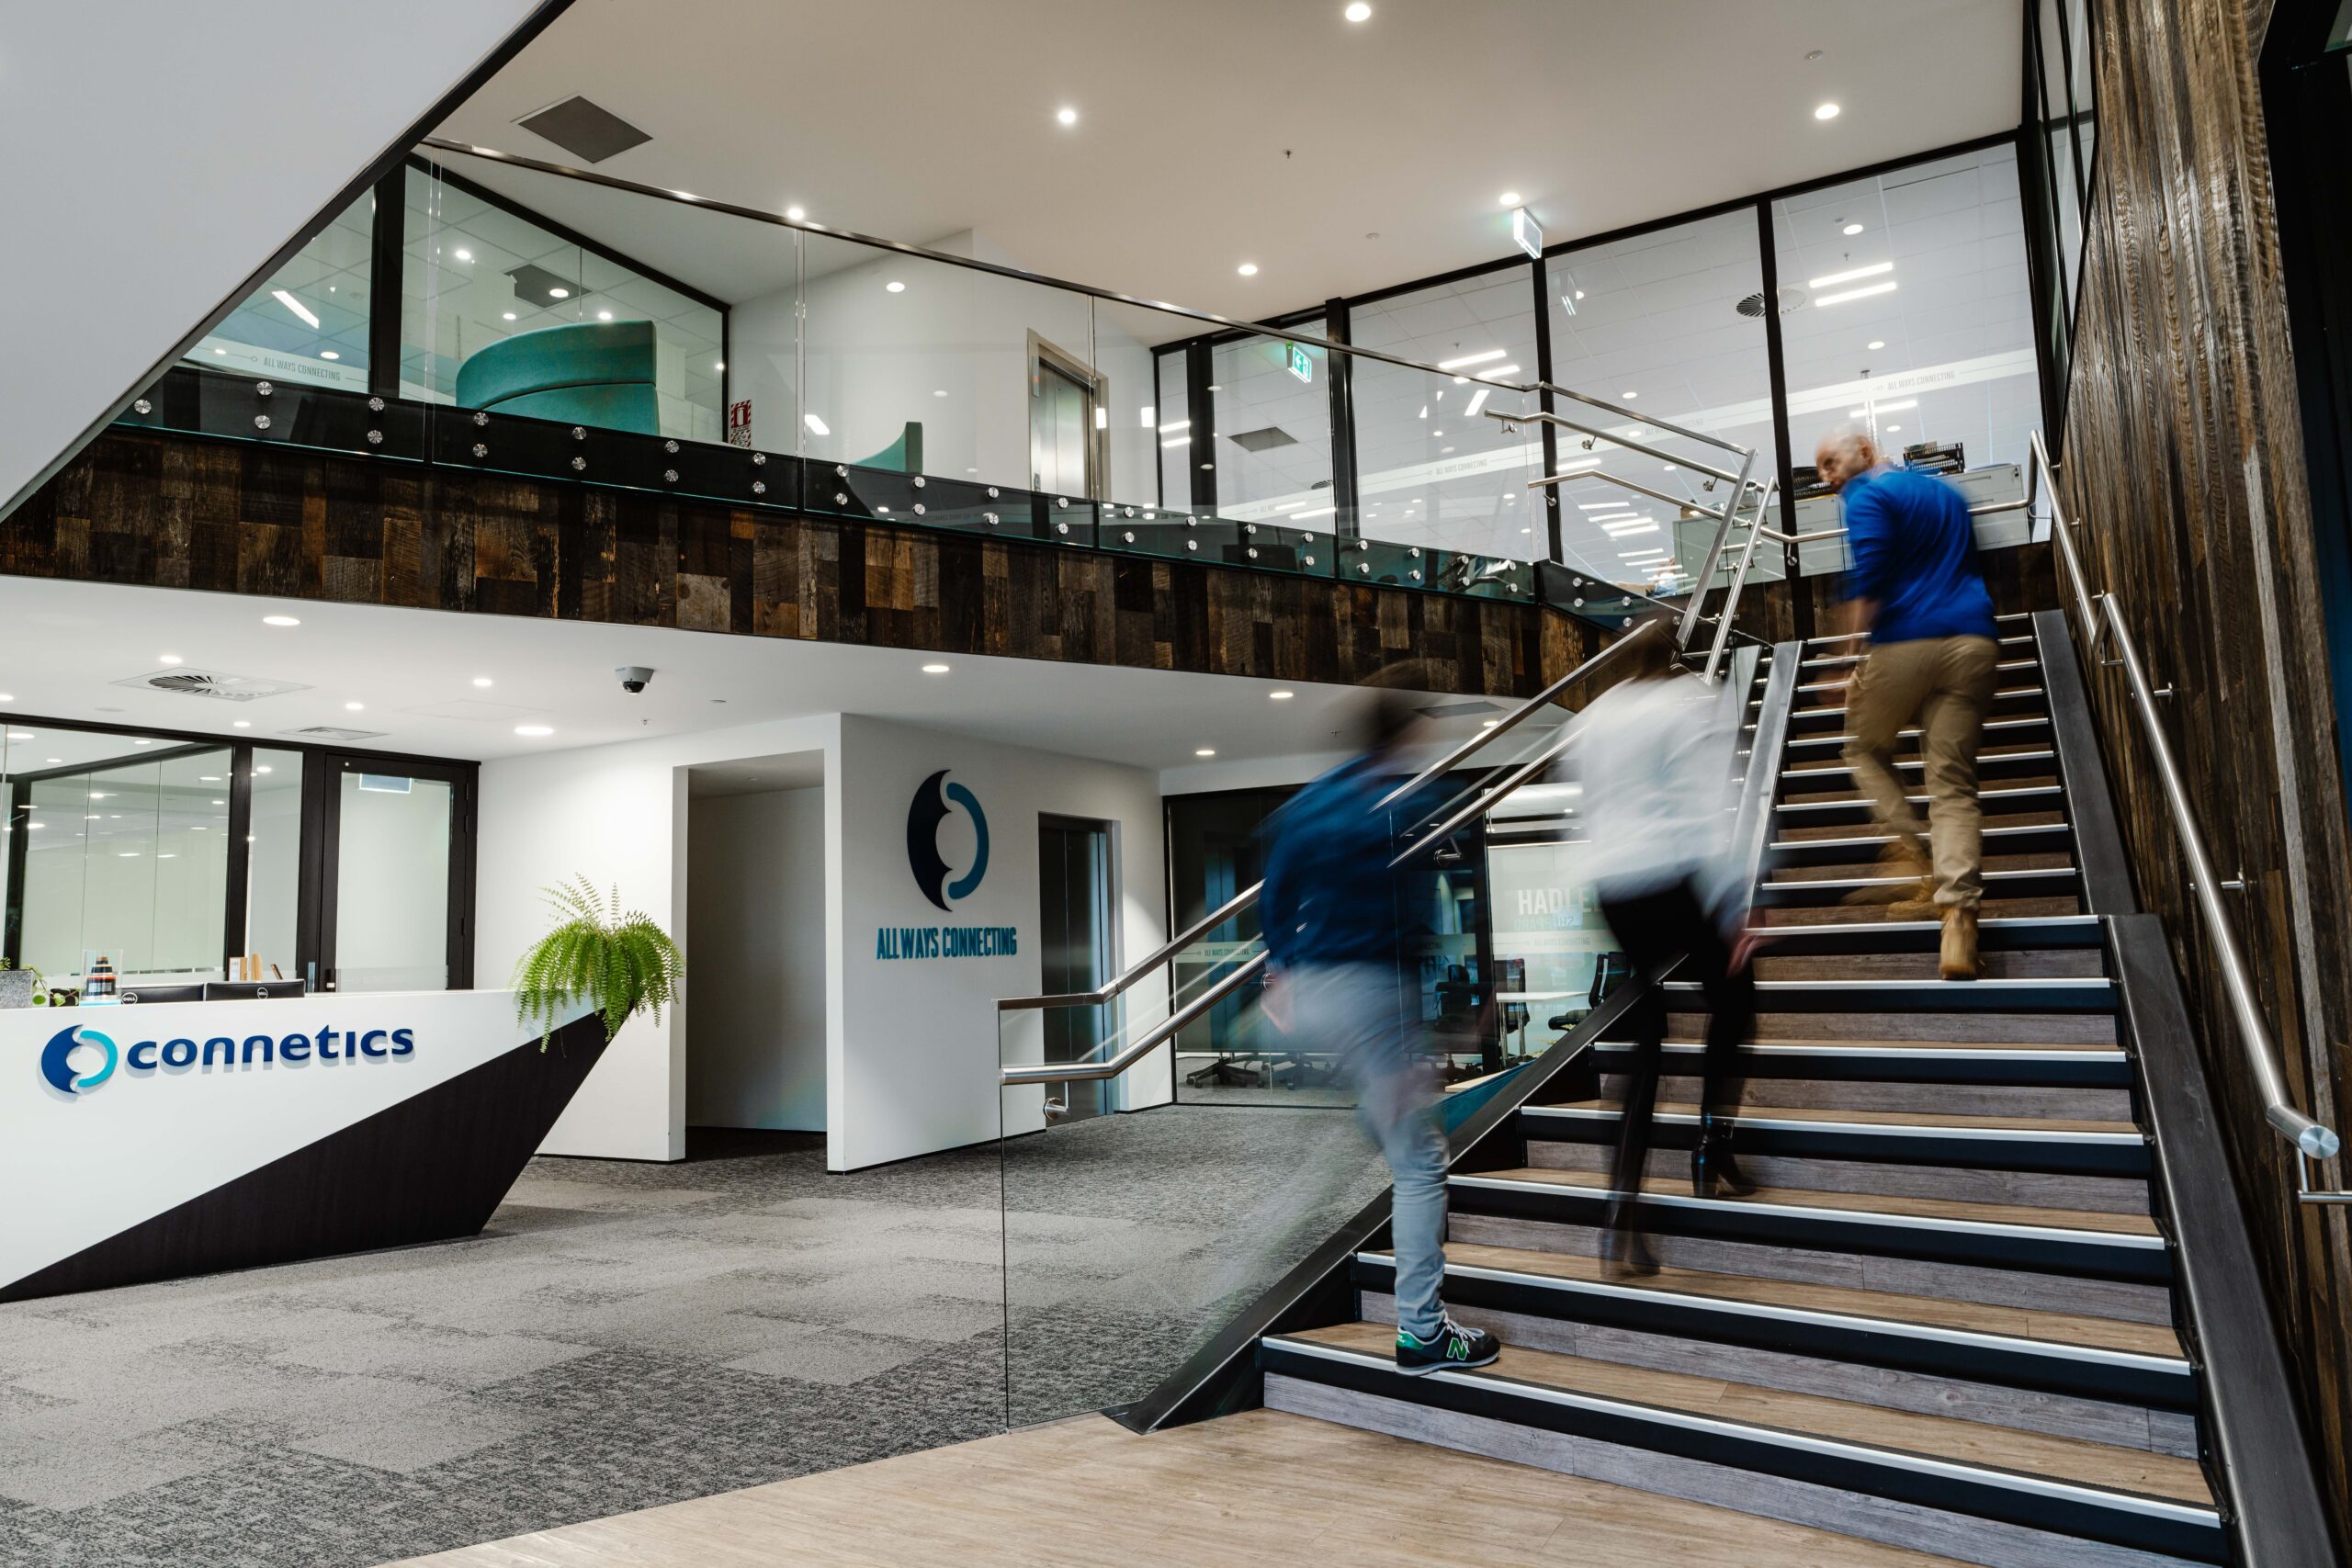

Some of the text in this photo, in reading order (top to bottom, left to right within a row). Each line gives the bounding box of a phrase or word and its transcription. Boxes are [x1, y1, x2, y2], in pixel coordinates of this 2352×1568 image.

[264, 356, 341, 381] ALL WAYS CONNECTING
[1887, 370, 1956, 390] ALL WAYS CONNECTING
[876, 927, 1017, 960] ALL WAYS CONNECTING
[126, 1024, 414, 1069] connetics
